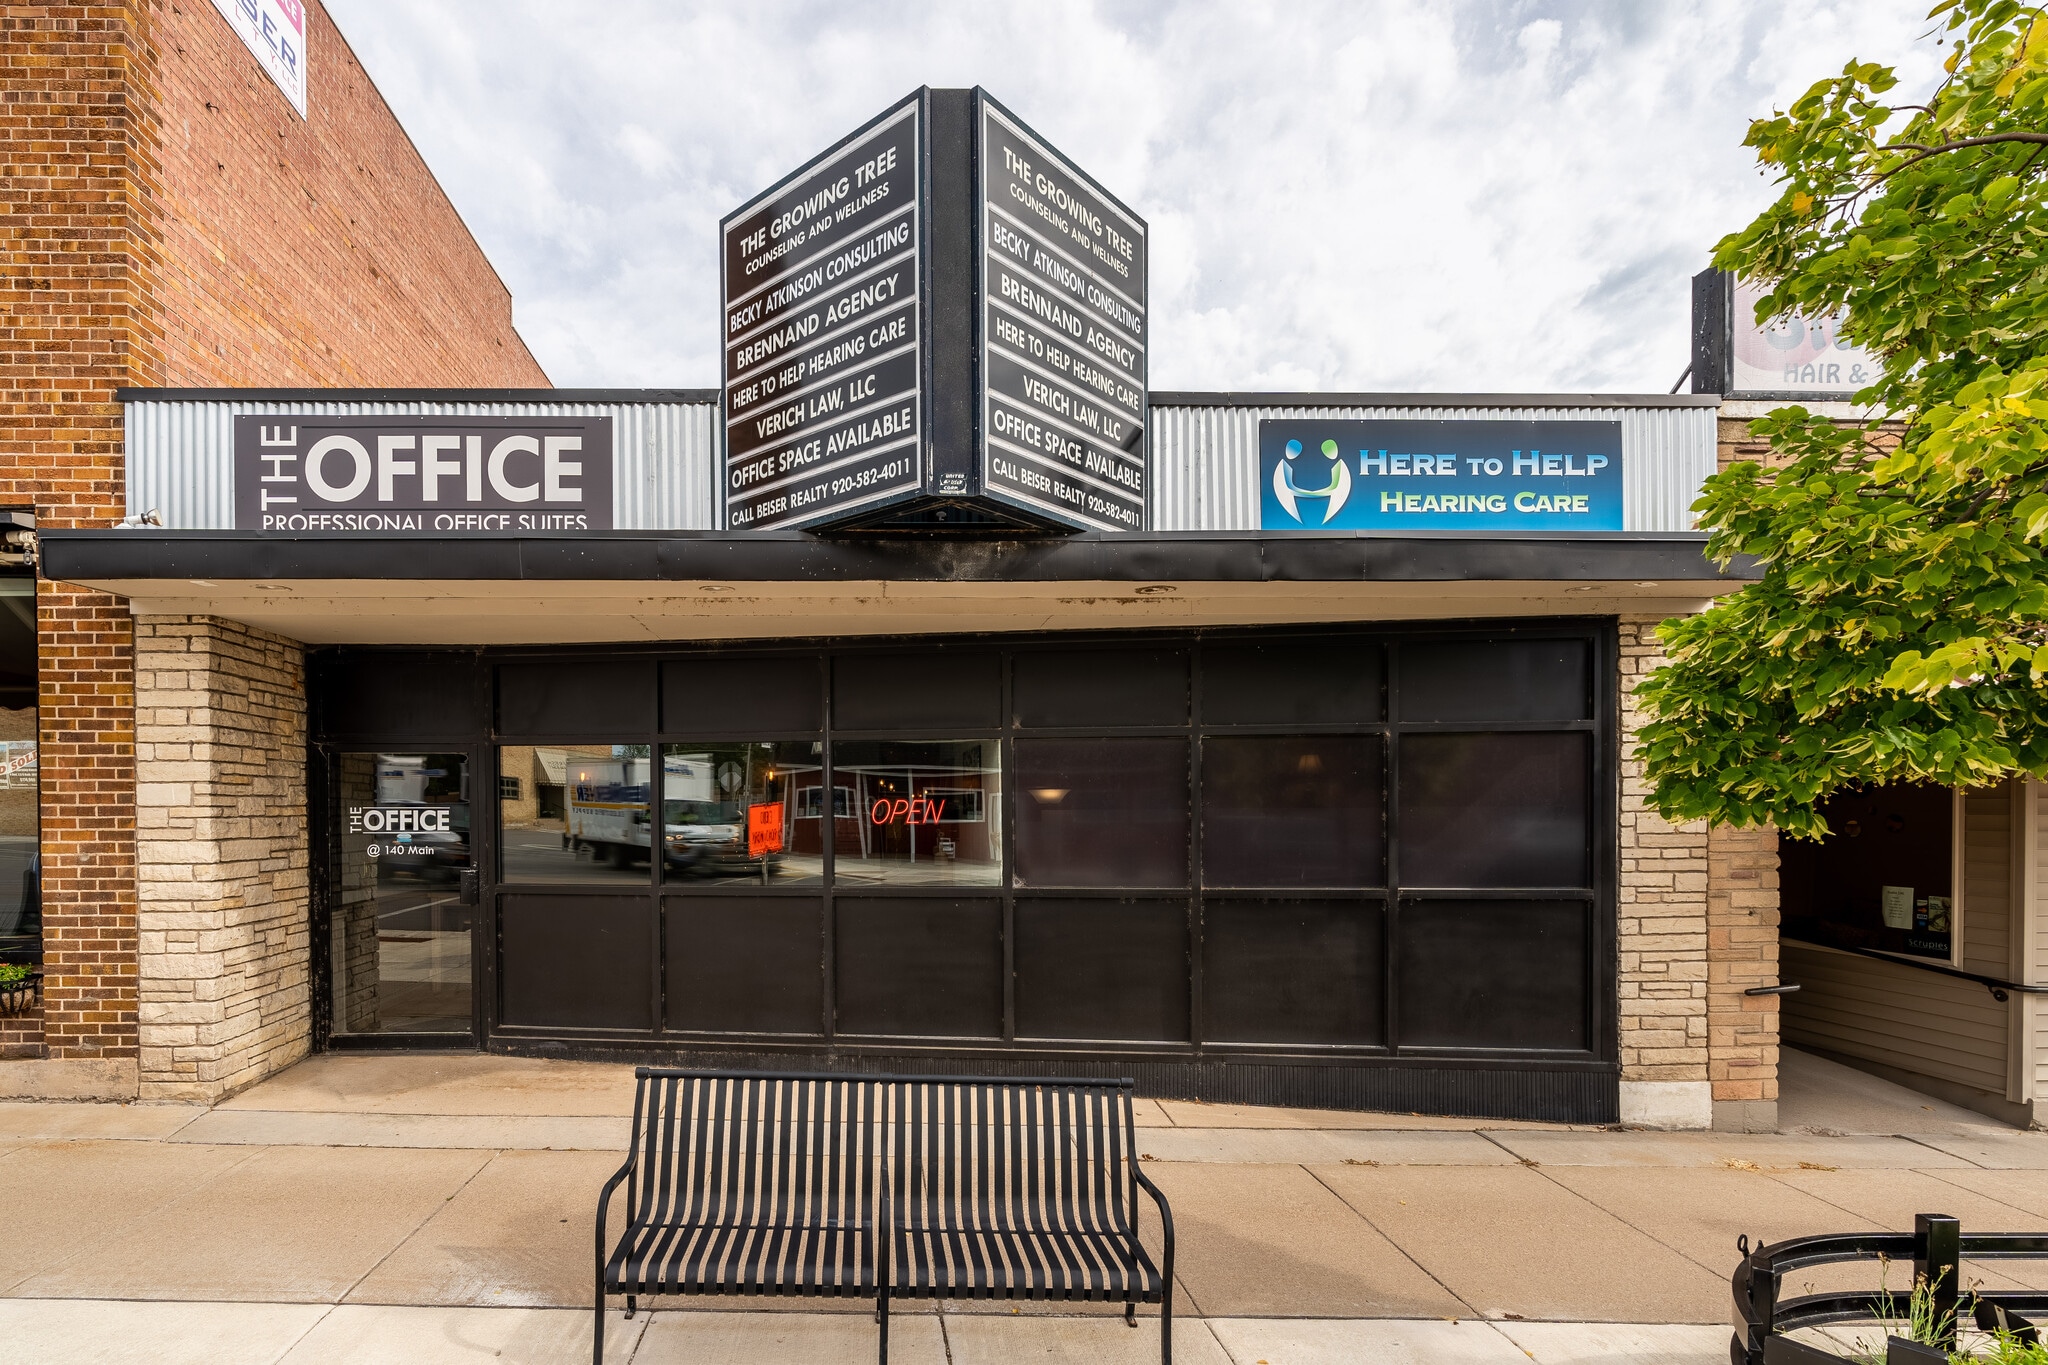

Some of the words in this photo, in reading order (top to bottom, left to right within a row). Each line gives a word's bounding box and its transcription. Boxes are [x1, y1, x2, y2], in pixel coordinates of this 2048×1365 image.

[740, 226, 766, 258] THE
[770, 176, 850, 239] GROWING
[855, 146, 897, 188] TREE
[745, 232, 805, 275] COUNSELING
[808, 216, 832, 239] AND
[836, 181, 889, 223] WELLNESS
[1003, 146, 1031, 185] THE
[1036, 173, 1102, 236] GROWING
[1105, 224, 1133, 262] TREE
[1010, 182, 1069, 234] COUNSELING
[1071, 227, 1090, 249] AND
[1092, 242, 1129, 279] WELLNESS
[730, 300, 763, 333] BECKY
[765, 267, 823, 314] ATKINSON
[826, 222, 909, 281] CONSULTING
[994, 222, 1030, 261] BECKY
[1033, 249, 1085, 298] ATKINSON
[1087, 284, 1141, 335] CONSULTING
[736, 313, 819, 370] BRENNAND
[825, 273, 899, 327] AGENCY
[1001, 273, 1082, 338] BRENNAND
[1086, 327, 1135, 371] AGENCY
[733, 388, 758, 410] HERE
[761, 376, 776, 396] TO
[779, 362, 805, 389] HELP
[809, 336, 865, 375] HEARING
[869, 317, 906, 348] CARE
[996, 317, 1025, 349] HERE
[1028, 334, 1043, 358] TO
[1046, 344, 1071, 369] HELP
[1073, 361, 1114, 397] HEARING
[1117, 385, 1139, 411] CARE
[1783, 363, 1840, 384] HAIR
[1849, 363, 1868, 384] &
[756, 403, 804, 439] VERICH
[810, 388, 844, 419] LAW,
[850, 374, 876, 403] LLC
[1023, 375, 1070, 416] VERICH
[1074, 401, 1100, 434] LAW,
[1103, 416, 1121, 442] LLC
[260, 425, 298, 511] THE
[304, 434, 583, 502] OFFICE
[732, 457, 775, 489] OFFICE
[779, 440, 821, 472] SPACE
[826, 407, 911, 456] AVAILABLE
[994, 409, 1041, 447] OFFICE
[1045, 431, 1082, 465] SPACE
[1085, 451, 1141, 491] AVAILABLE
[1359, 449, 1457, 477] HERE
[1512, 449, 1609, 477] HELP
[263, 514, 422, 530] PROFESSIONAL
[434, 514, 510, 530] OFFICE
[518, 514, 588, 530] SUITES
[732, 508, 754, 526] CALL
[756, 498, 787, 519] BEISER
[791, 483, 828, 508] REALTY
[832, 457, 909, 495] 920-582-4011
[993, 457, 1018, 481] CALL
[1021, 469, 1051, 494] BEISER
[1054, 481, 1086, 506] REALTY
[1088, 495, 1139, 527] 920-582-4011
[1380, 491, 1506, 513] HEARING
[1514, 491, 1589, 514] CARE
[349, 807, 362, 834] THE
[363, 810, 450, 831] OFFICE
[872, 799, 946, 825] OPEN
[367, 844, 381, 857] @
[385, 845, 404, 855] 140
[408, 845, 435, 855] Main
